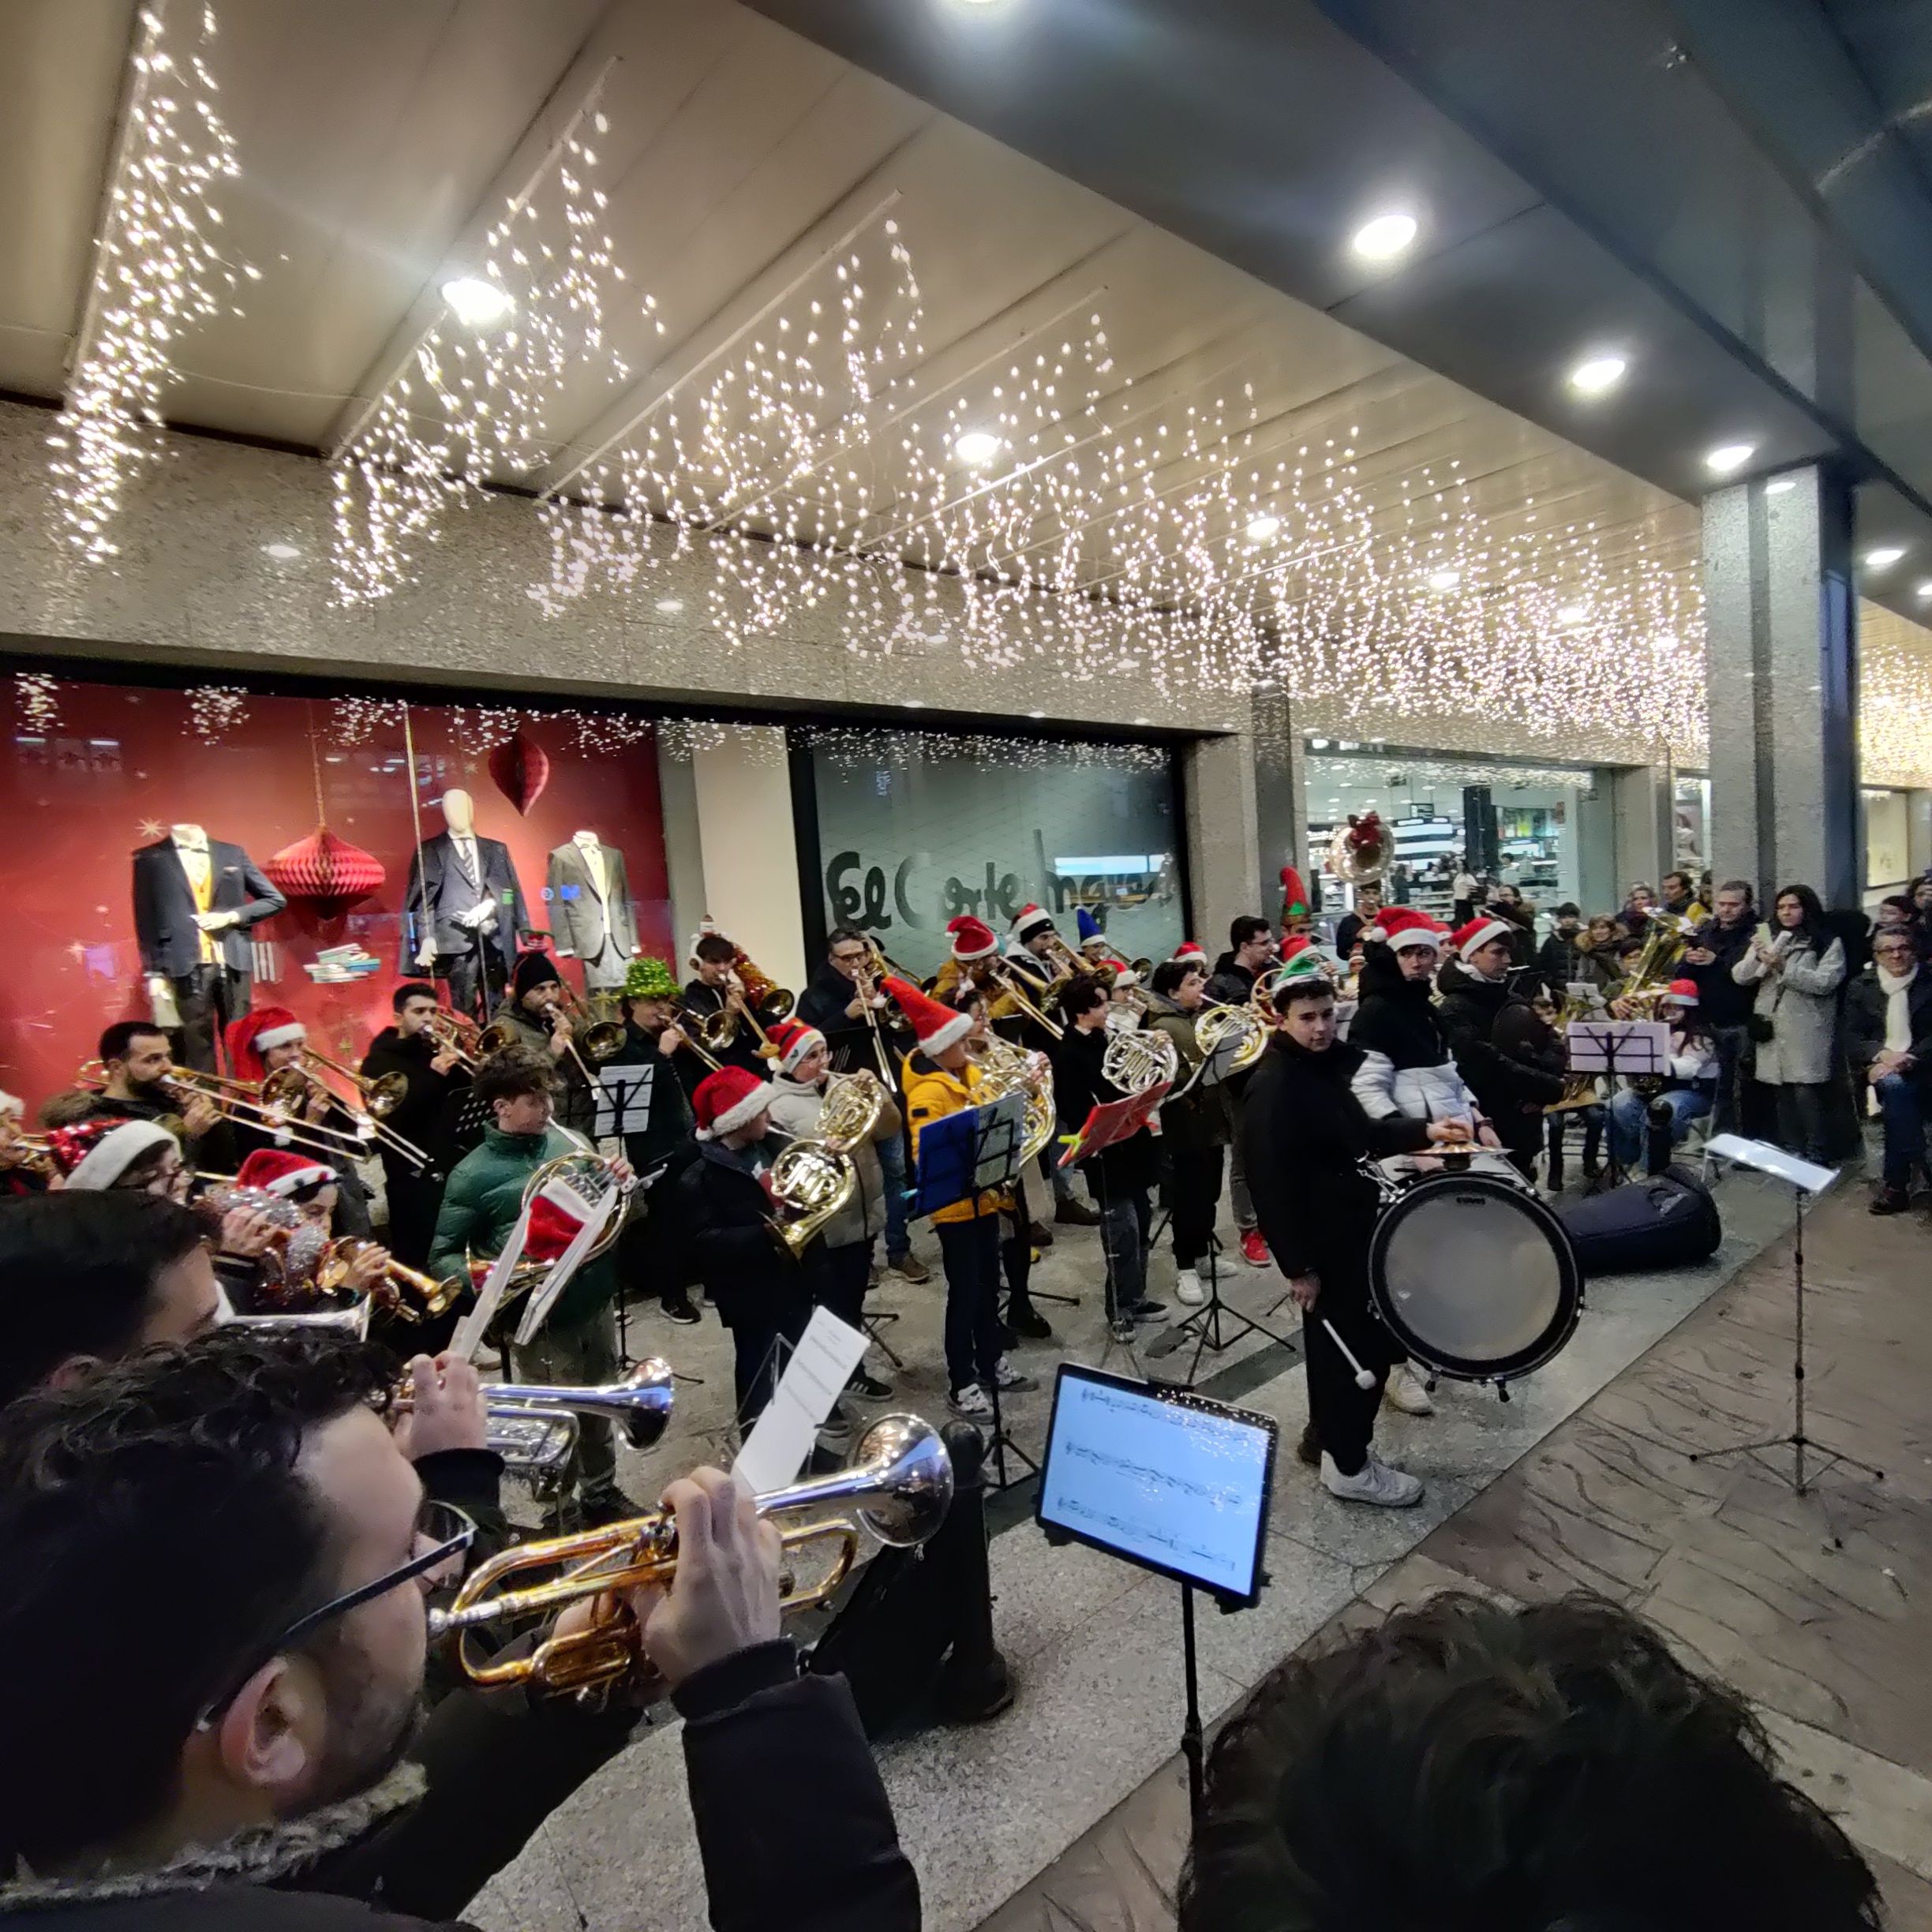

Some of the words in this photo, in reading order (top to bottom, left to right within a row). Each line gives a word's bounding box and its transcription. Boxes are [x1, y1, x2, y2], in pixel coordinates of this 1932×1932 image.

[826, 851, 892, 931] El
[894, 852, 1022, 930] Corte
[1032, 829, 1174, 933] Ing
